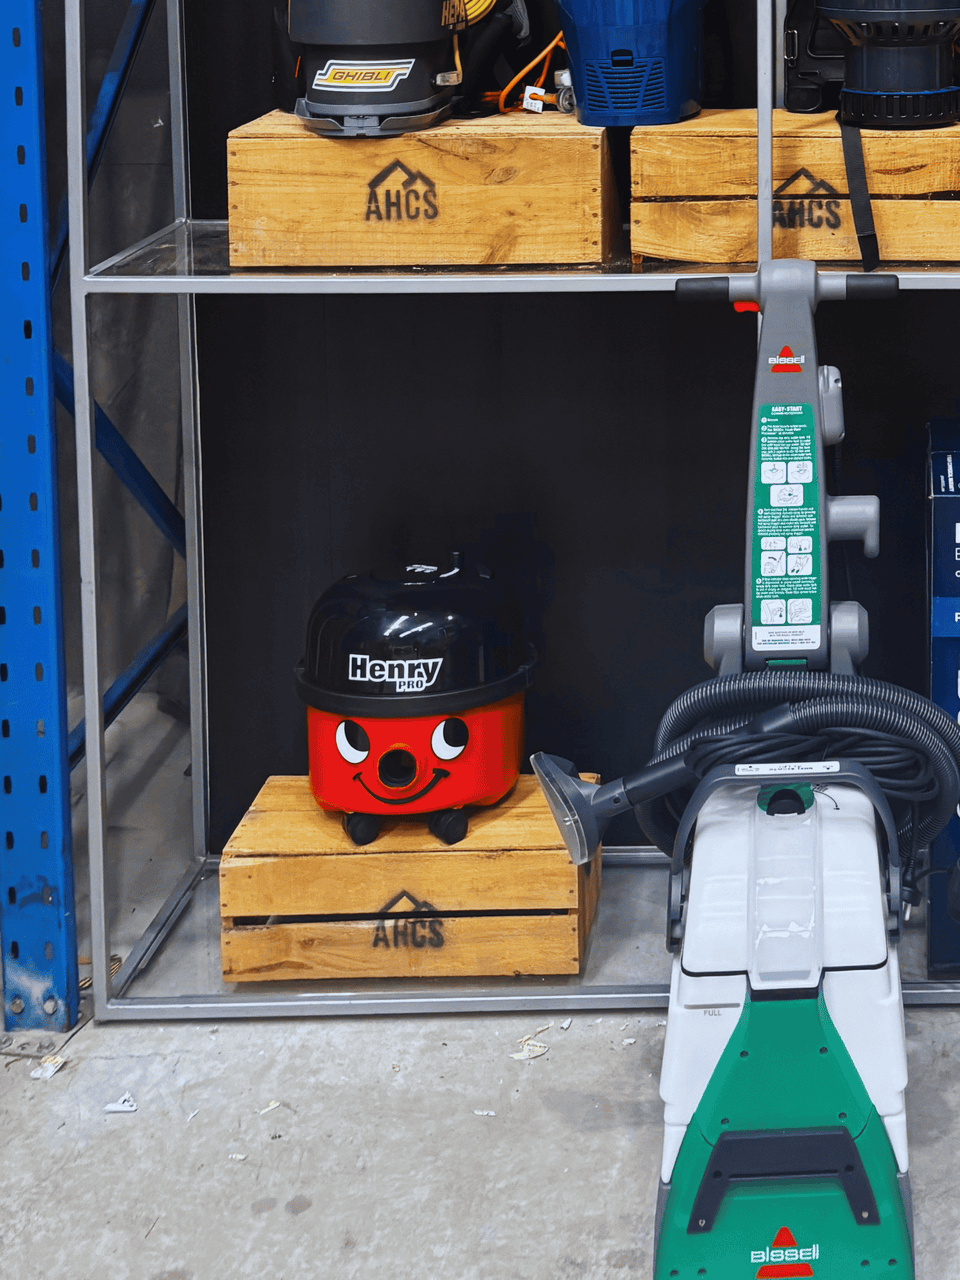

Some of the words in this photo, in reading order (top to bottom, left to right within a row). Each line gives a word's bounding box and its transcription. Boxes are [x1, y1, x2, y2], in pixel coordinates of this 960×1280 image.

[332, 71, 391, 81] GHIBLI
[366, 189, 439, 221] AHCS
[773, 200, 841, 230] AHCS
[350, 656, 441, 683] Henry
[397, 678, 425, 692] PRO
[373, 919, 445, 949] AHCS
[703, 1009, 722, 1017] FULL
